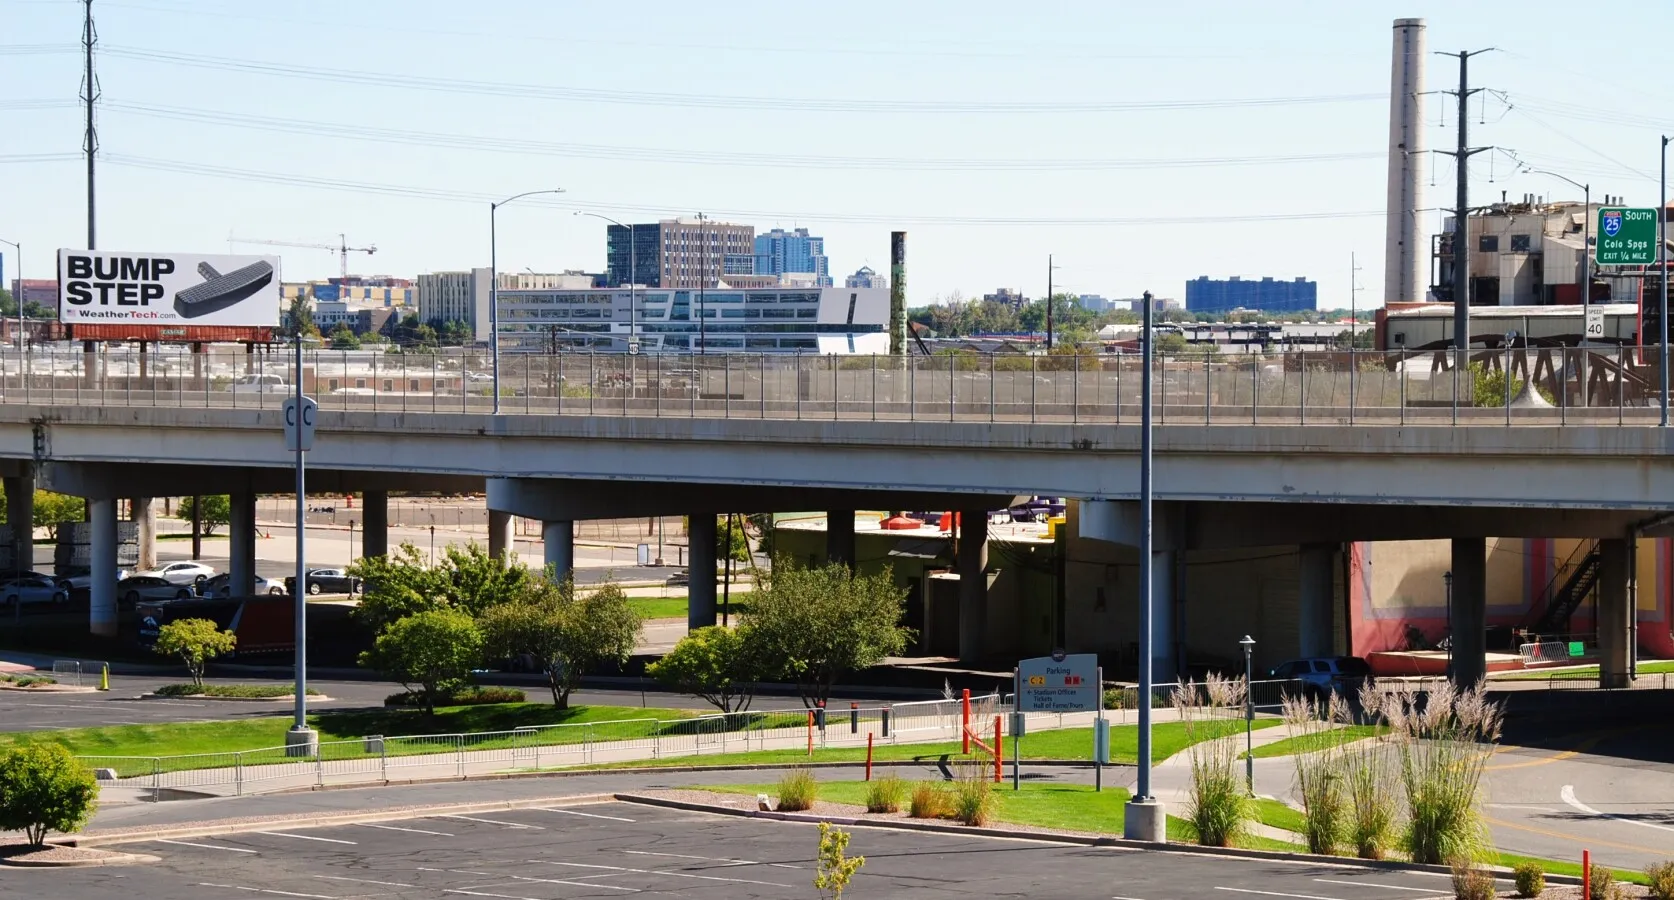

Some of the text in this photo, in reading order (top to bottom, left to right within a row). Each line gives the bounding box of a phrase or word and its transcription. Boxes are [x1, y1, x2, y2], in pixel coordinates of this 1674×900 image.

[1625, 210, 1652, 221] SOUTH
[1606, 219, 1619, 231] 25
[1604, 239, 1647, 250] Colo Spgs
[1603, 252, 1618, 260] EXIT
[1632, 252, 1647, 260] MILE
[67, 255, 175, 281] BUMP
[66, 281, 164, 306] STEP
[1588, 324, 1602, 334] 40
[286, 405, 311, 426] C C
